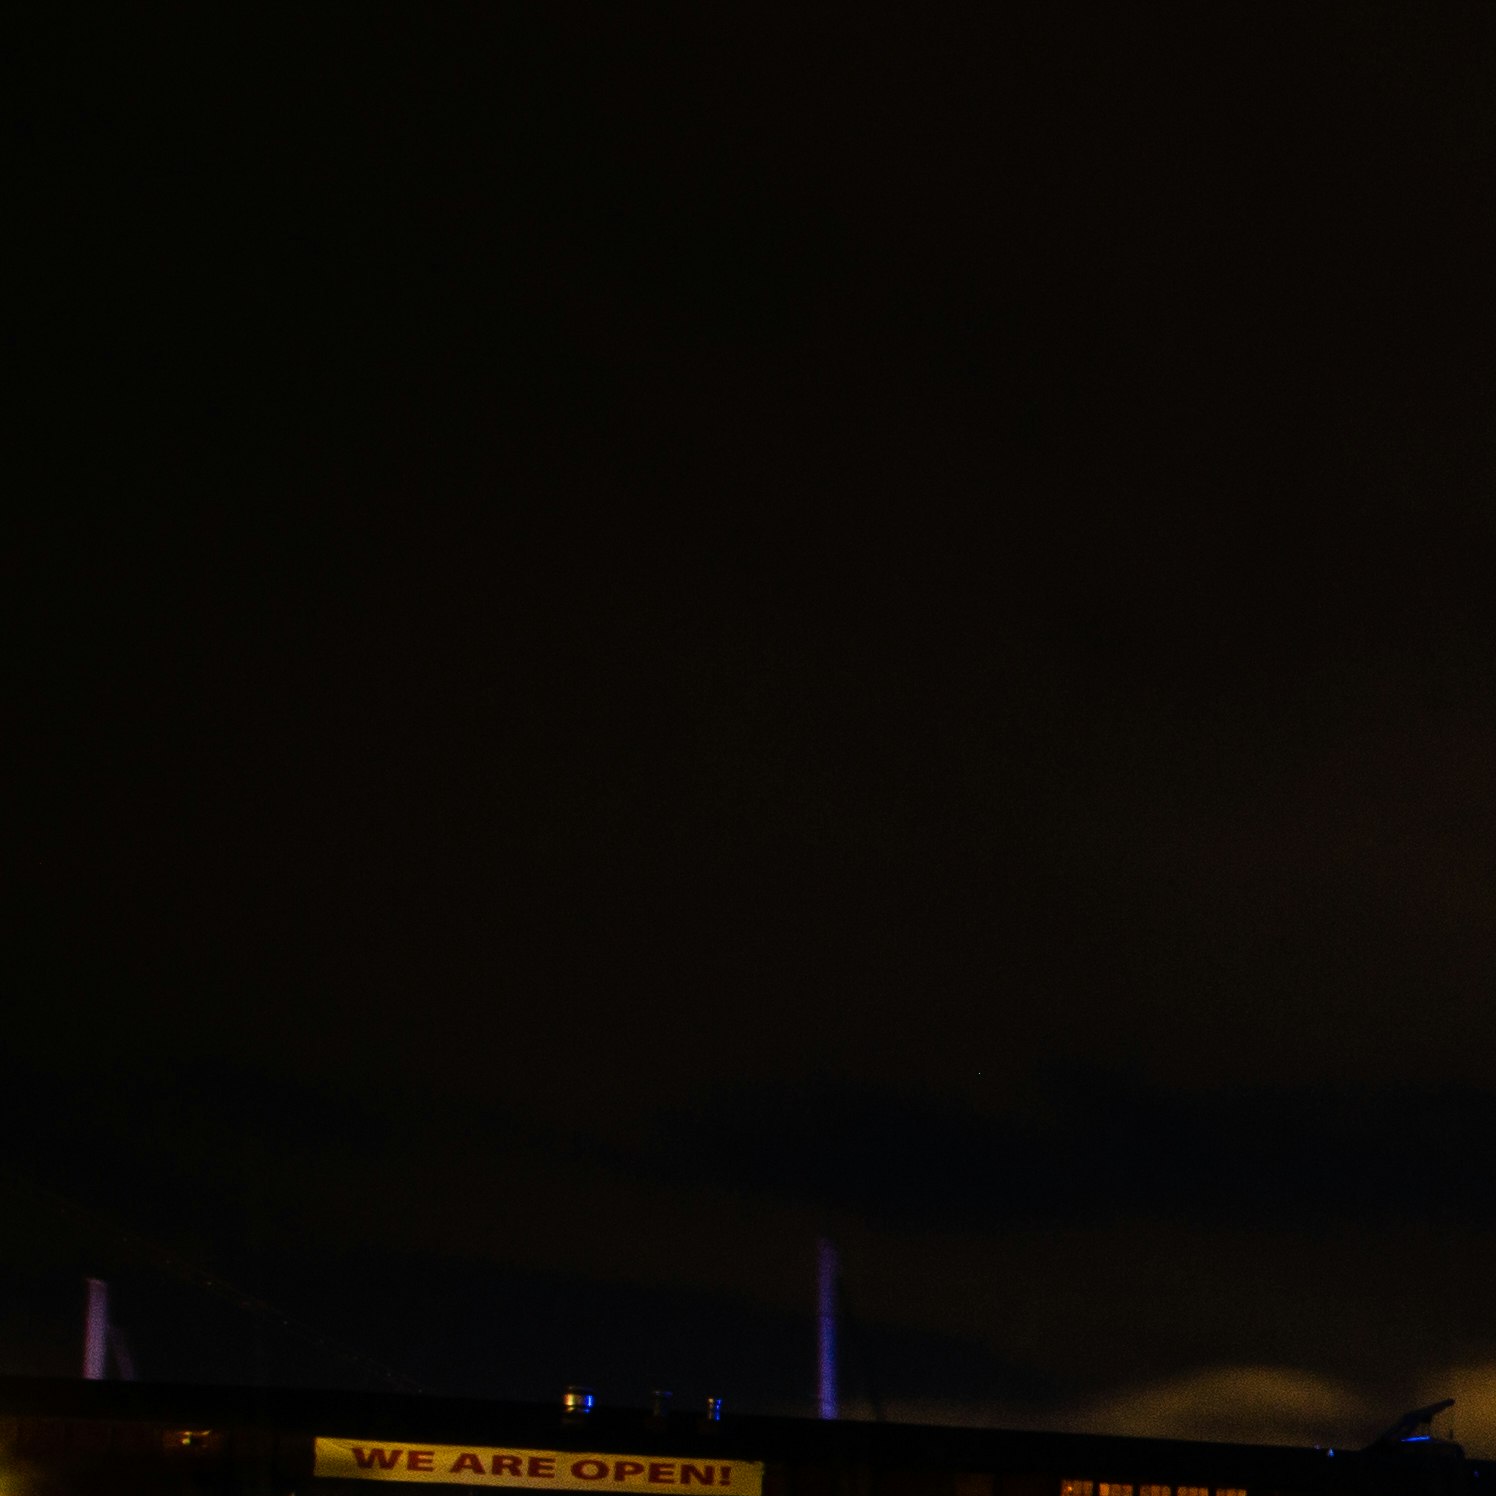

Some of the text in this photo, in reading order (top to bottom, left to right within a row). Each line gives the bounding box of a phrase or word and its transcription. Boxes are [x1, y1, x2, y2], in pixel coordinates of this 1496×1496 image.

[352, 1447, 732, 1487] WE ARE OPEN!
